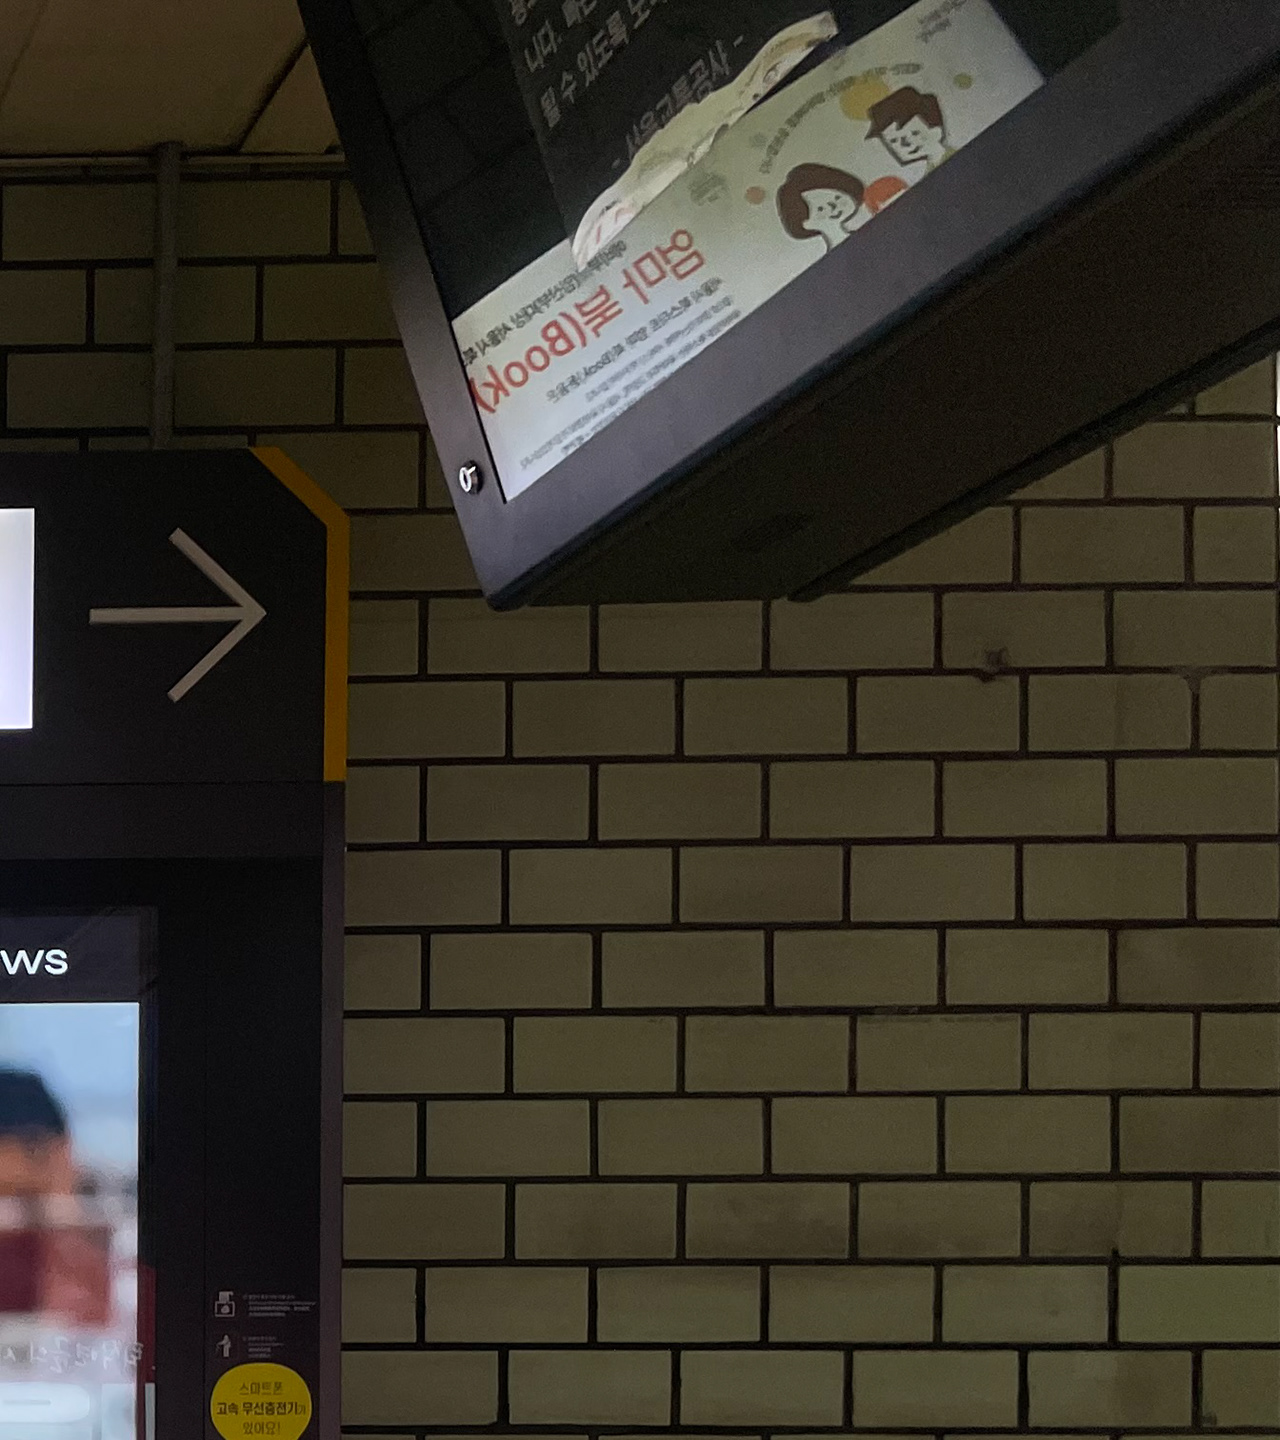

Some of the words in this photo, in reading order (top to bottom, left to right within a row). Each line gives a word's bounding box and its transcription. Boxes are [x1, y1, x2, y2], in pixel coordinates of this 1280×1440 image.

[239, 1382, 283, 1395] 스마트폰
[216, 1402, 238, 1415] 고속
[242, 1402, 306, 1415] 무선충전기가
[243, 1421, 281, 1435] 있어요!
